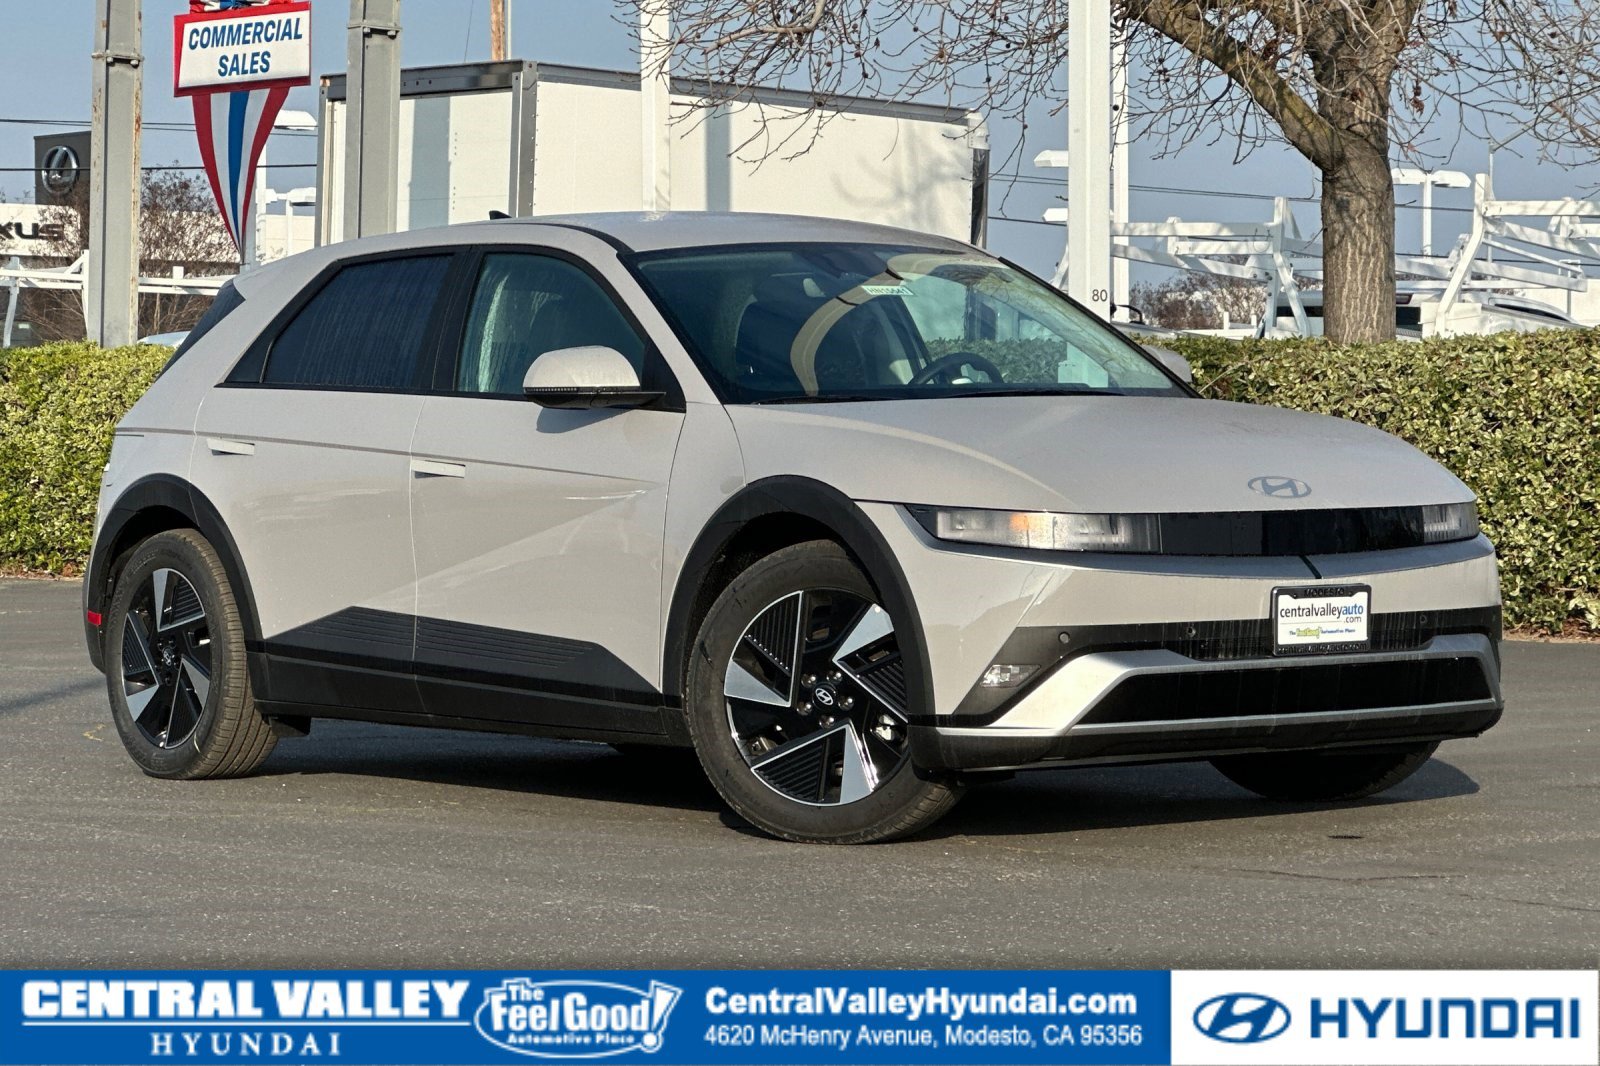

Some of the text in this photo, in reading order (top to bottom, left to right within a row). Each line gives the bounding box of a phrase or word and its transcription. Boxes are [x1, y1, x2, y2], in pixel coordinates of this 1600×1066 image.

[188, 17, 303, 51] COMMERCIAL
[217, 50, 271, 78] SALES
[1091, 288, 1108, 302] 80
[1303, 587, 1345, 597] MODESTO
[1280, 603, 1364, 619] centralvalleyauto
[1343, 615, 1362, 624] .com
